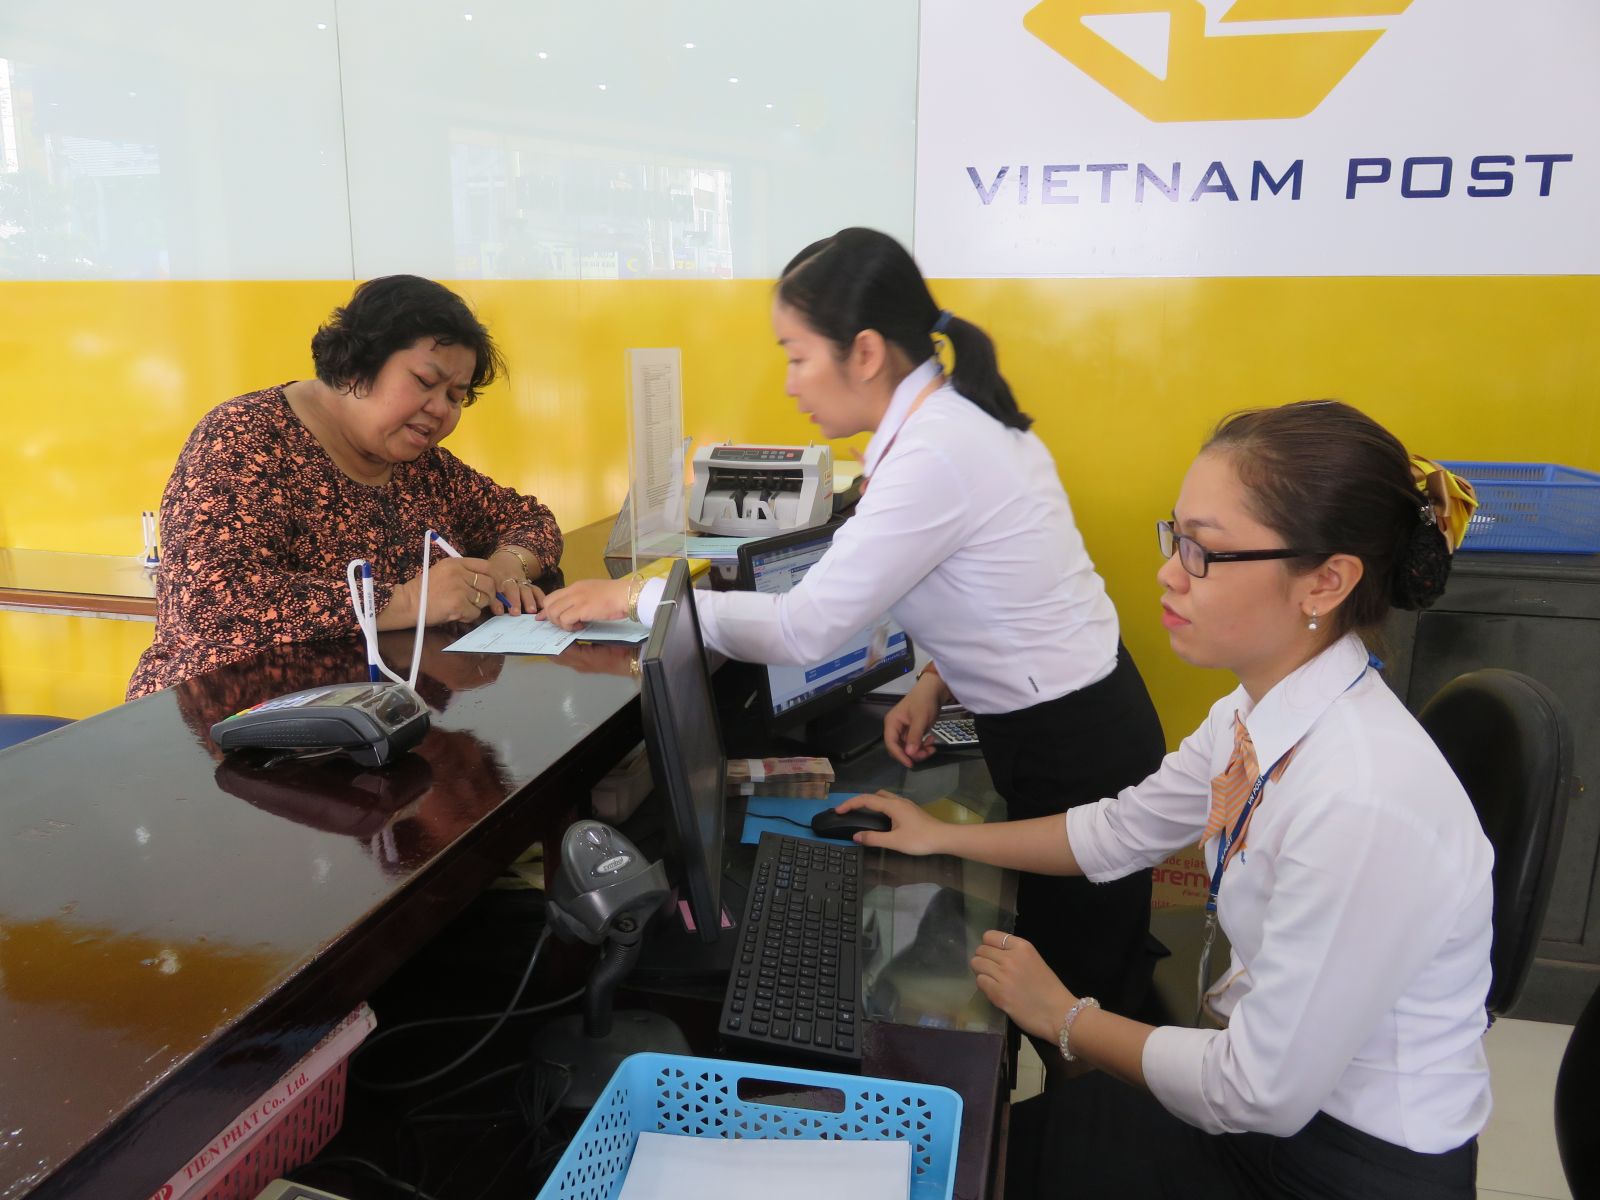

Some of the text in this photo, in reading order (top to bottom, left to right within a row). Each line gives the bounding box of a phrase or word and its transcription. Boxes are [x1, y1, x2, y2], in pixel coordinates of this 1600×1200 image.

[966, 153, 1573, 204] VIETNAM POST
[287, 1072, 310, 1096] Ltd.
